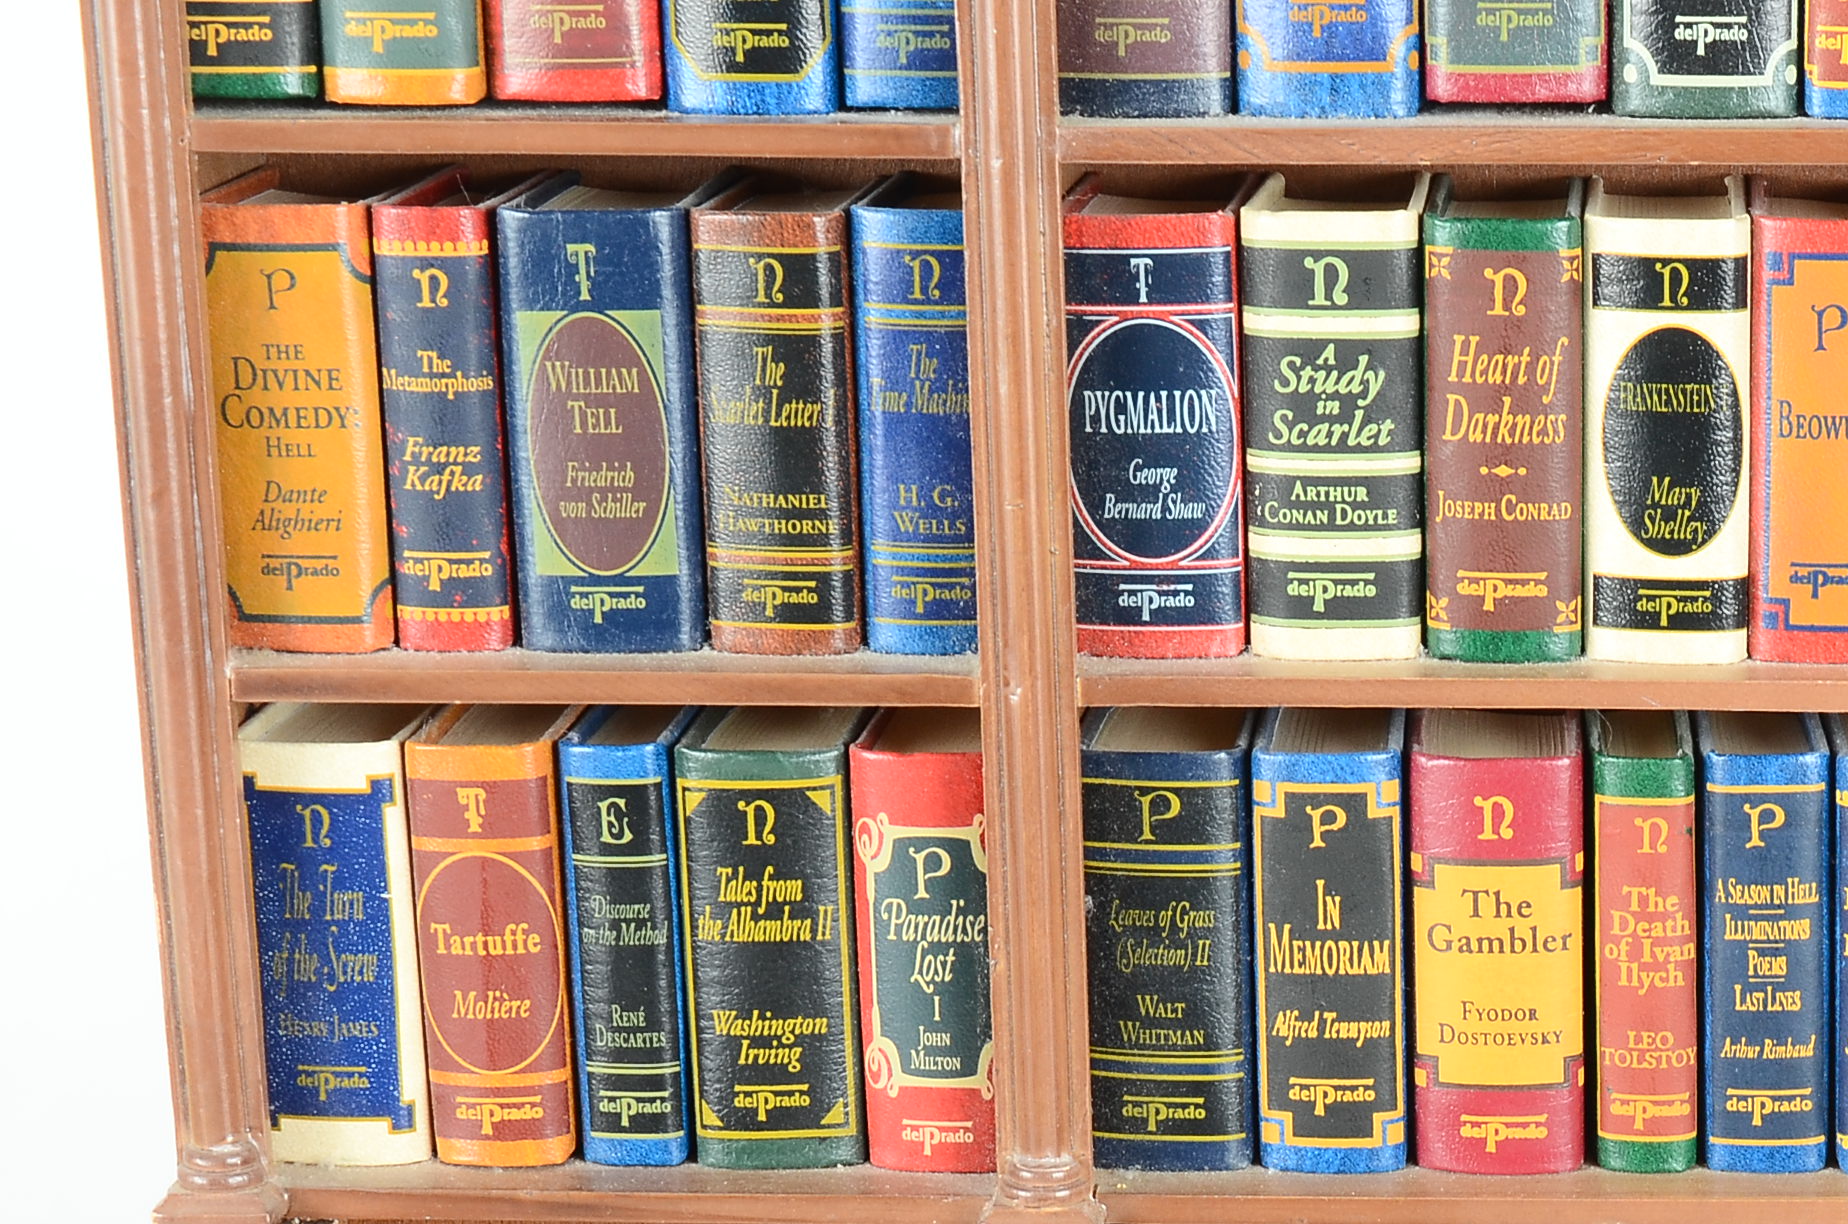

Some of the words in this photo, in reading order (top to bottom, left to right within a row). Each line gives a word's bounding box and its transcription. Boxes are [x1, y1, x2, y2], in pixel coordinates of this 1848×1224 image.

[261, 344, 305, 360] THE
[418, 351, 452, 374] The
[1316, 343, 1336, 365] A
[383, 368, 494, 399] Metamorphosis
[1274, 354, 1384, 405] Study
[1448, 335, 1528, 385] Heart
[1536, 337, 1568, 403] of
[1084, 390, 1217, 436] PYGMALION
[1317, 395, 1340, 415] in
[1442, 394, 1567, 444] Darkness
[1269, 411, 1394, 448] Scarlet
[403, 437, 481, 462] Franz
[404, 467, 483, 498] Kafka
[565, 462, 634, 488] Friedrich
[1129, 459, 1177, 487] George
[264, 481, 327, 505] Dante
[560, 497, 586, 518] von
[590, 496, 647, 518] Schiller
[899, 485, 924, 506] H.
[1104, 494, 1162, 520] Bernard
[1167, 493, 1206, 520] Shaw
[1646, 476, 1701, 514] Mary
[252, 509, 342, 539] Alighieri
[717, 867, 758, 903] Tales
[760, 867, 803, 908] from
[1623, 885, 1680, 913] The
[1316, 879, 1341, 931] IN
[1461, 889, 1533, 919] The
[881, 898, 984, 944] Paradise
[1611, 911, 1689, 937] Death
[431, 923, 542, 953] Tartuffe
[1427, 923, 1572, 954] Gambler
[1605, 940, 1636, 961] of
[1642, 942, 1696, 961] Ivan
[912, 943, 955, 993] Lost
[1618, 963, 1684, 995] Ilych
[453, 991, 531, 1019] Molière
[712, 1011, 828, 1044] Washington
[1272, 1010, 1319, 1044] Alfred
[1324, 1010, 1390, 1048] Tennyson
[1627, 1030, 1674, 1049] LEO
[737, 1040, 803, 1071] Irving
[1601, 1046, 1696, 1069] TOLSTOY
